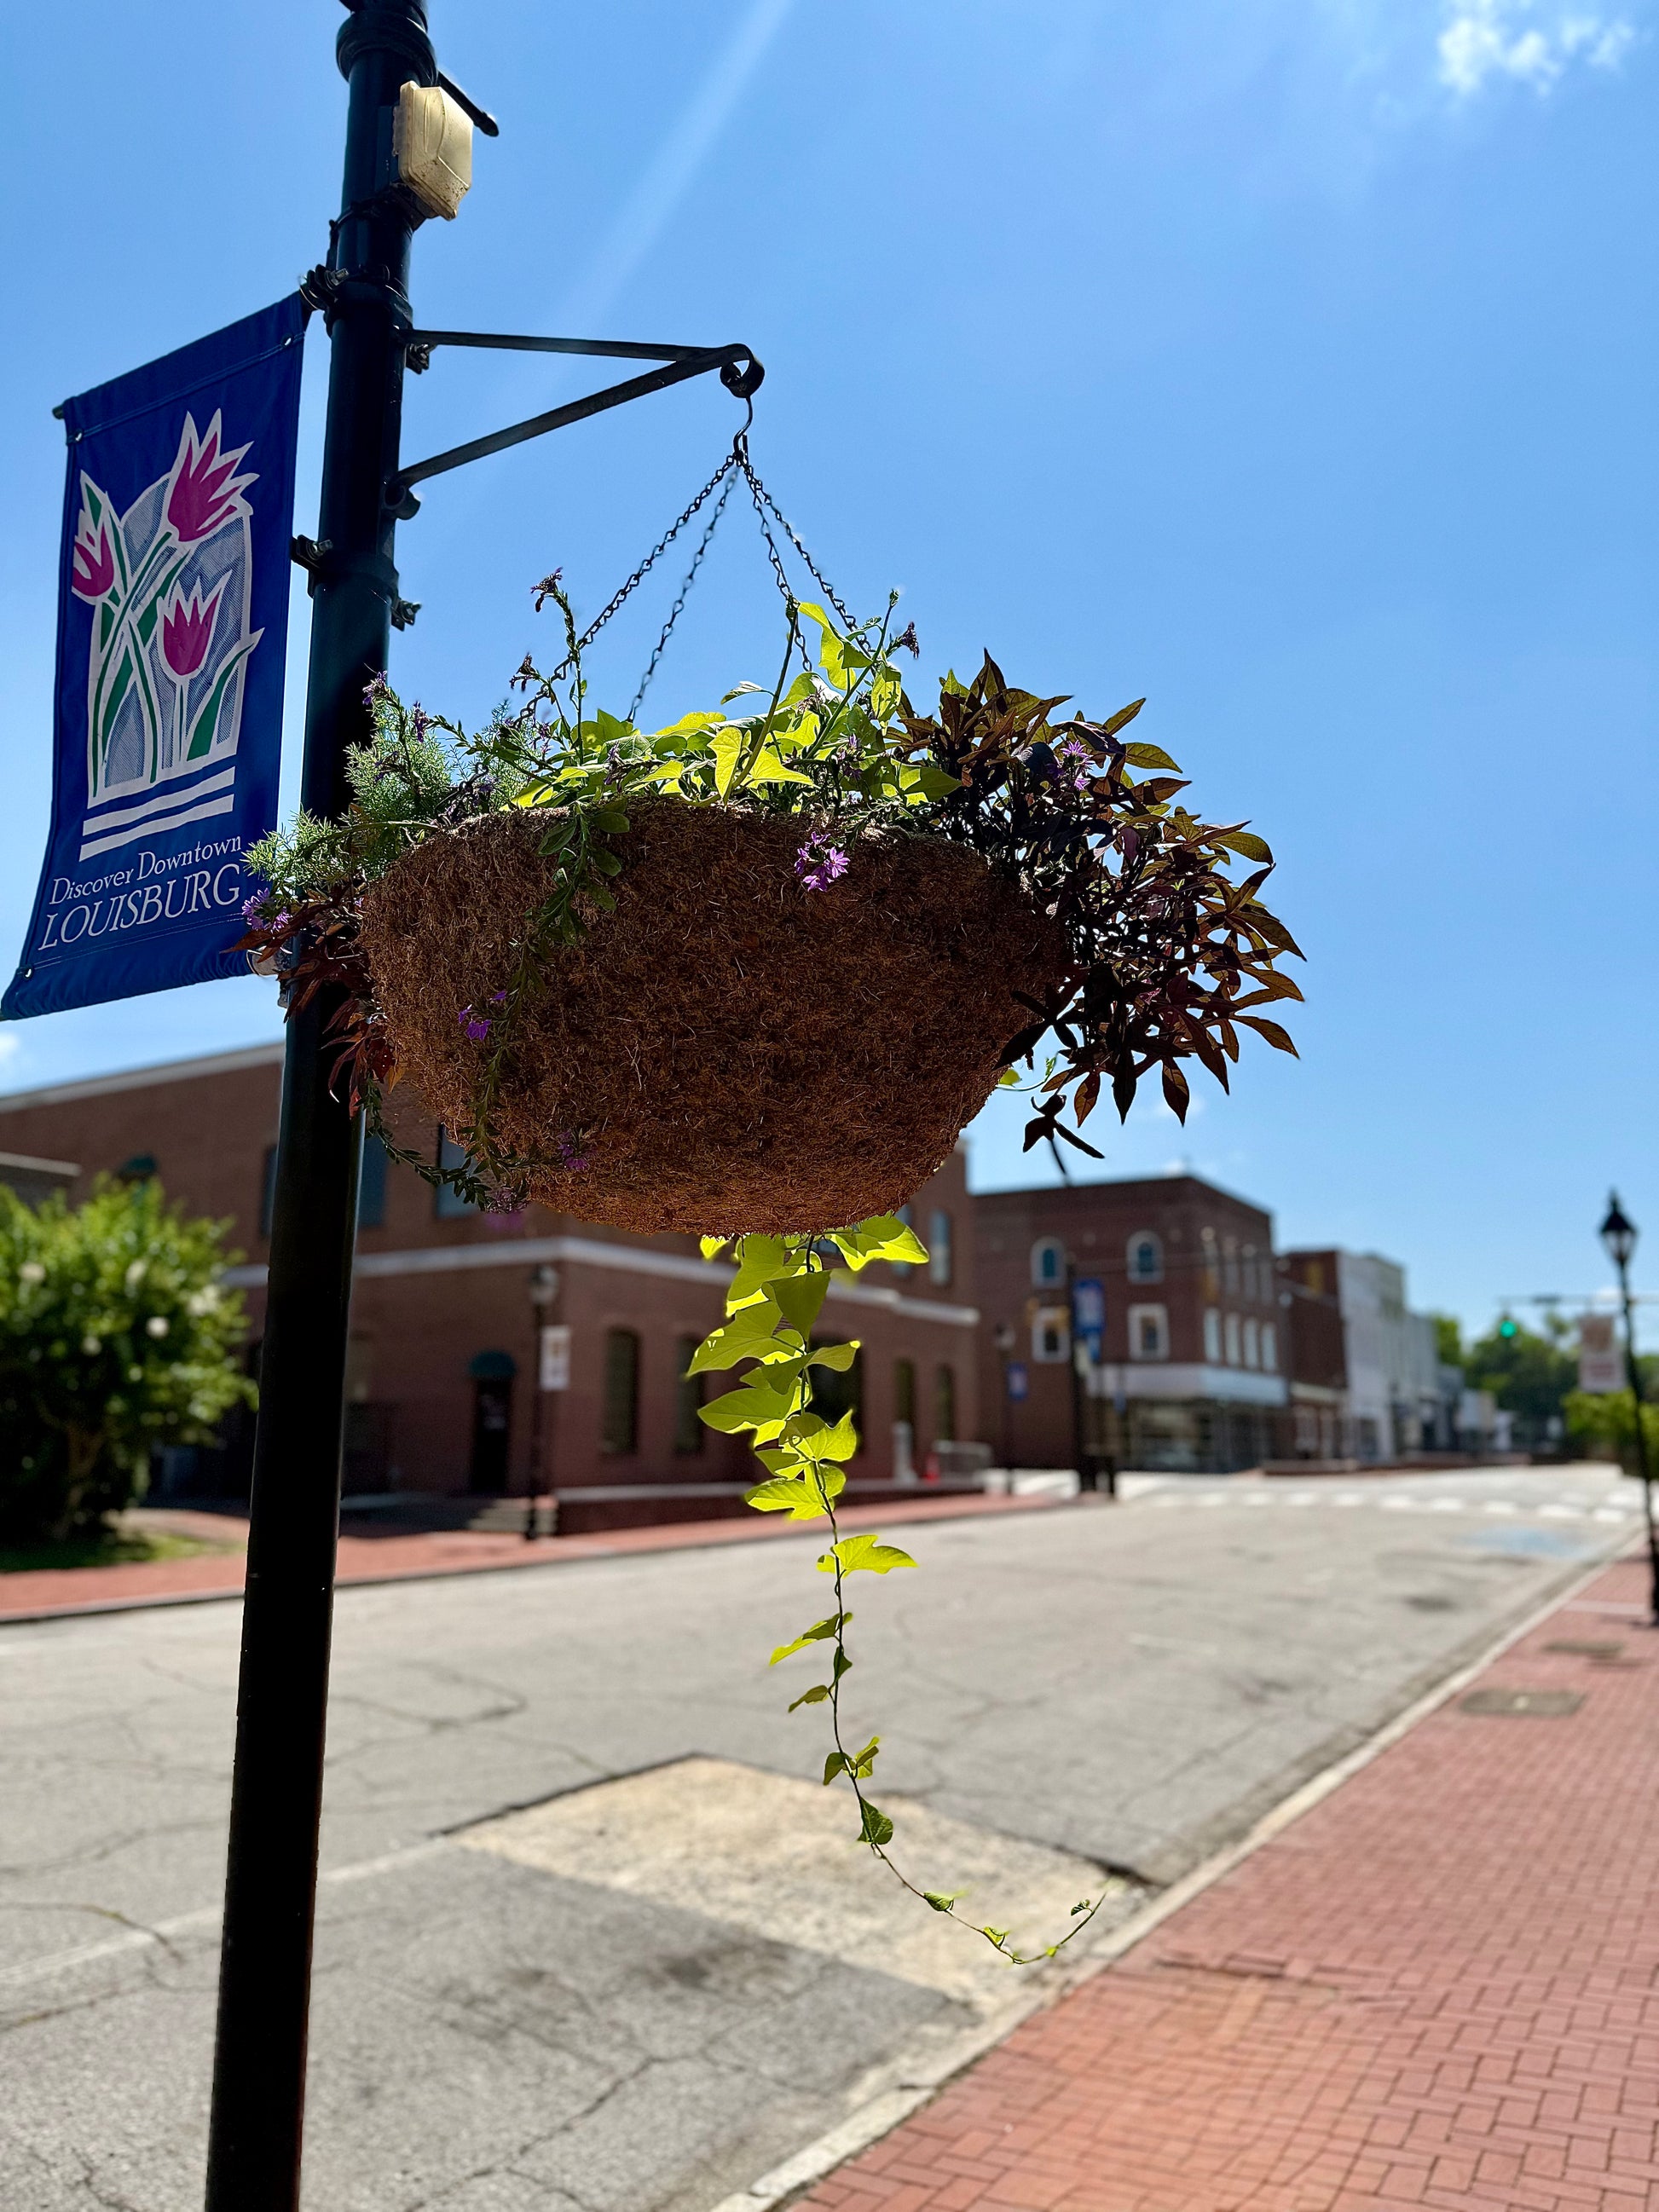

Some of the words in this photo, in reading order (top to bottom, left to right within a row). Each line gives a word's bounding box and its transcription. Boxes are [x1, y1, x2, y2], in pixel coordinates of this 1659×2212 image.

[38, 863, 240, 950] LOUISBURG
[49, 868, 134, 904] Discover
[136, 835, 241, 881] Downtown
